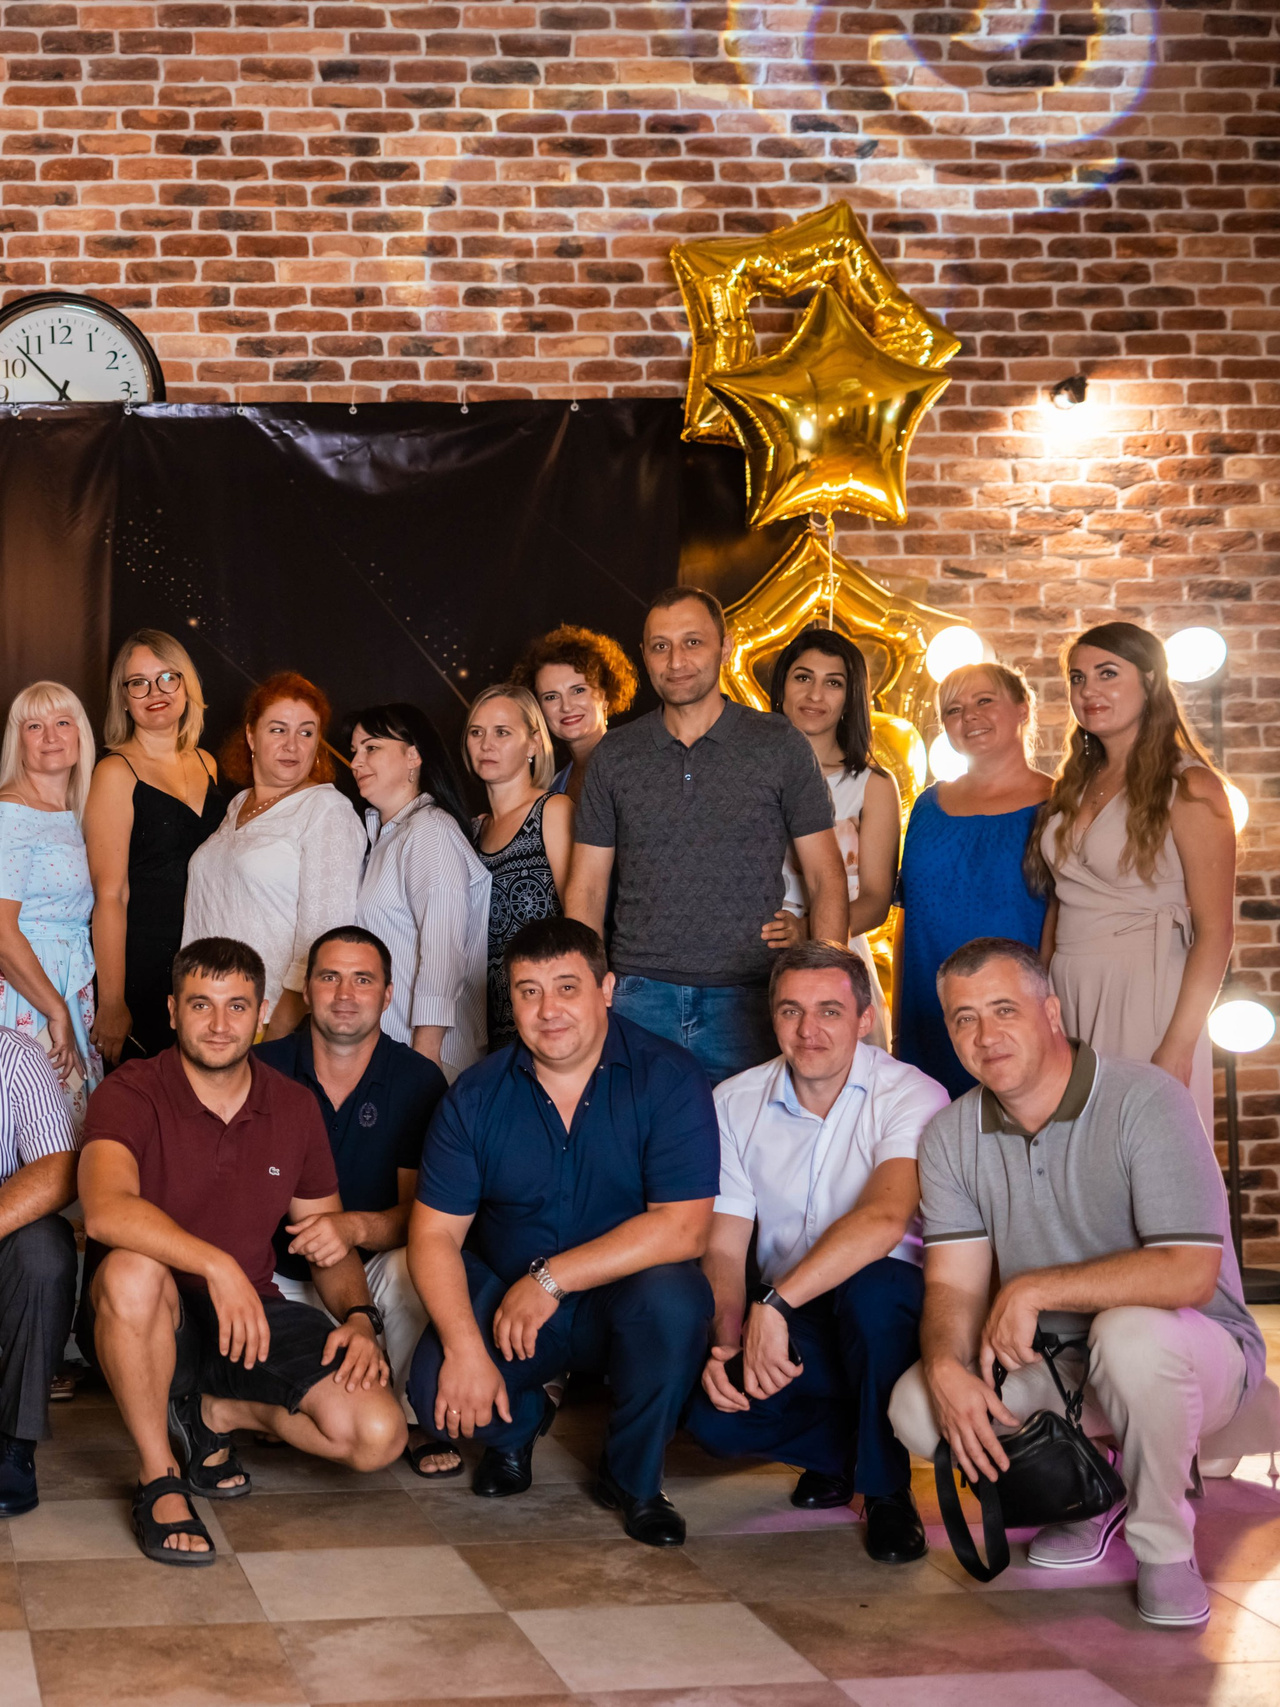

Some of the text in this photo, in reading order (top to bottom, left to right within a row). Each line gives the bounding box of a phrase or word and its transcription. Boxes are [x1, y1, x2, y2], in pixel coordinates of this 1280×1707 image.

[23, 334, 43, 355] 11
[48, 325, 73, 345] 12
[86, 332, 95, 352] 1
[3, 358, 27, 379] 10
[105, 350, 119, 370] 2
[120, 381, 133, 401] 3
